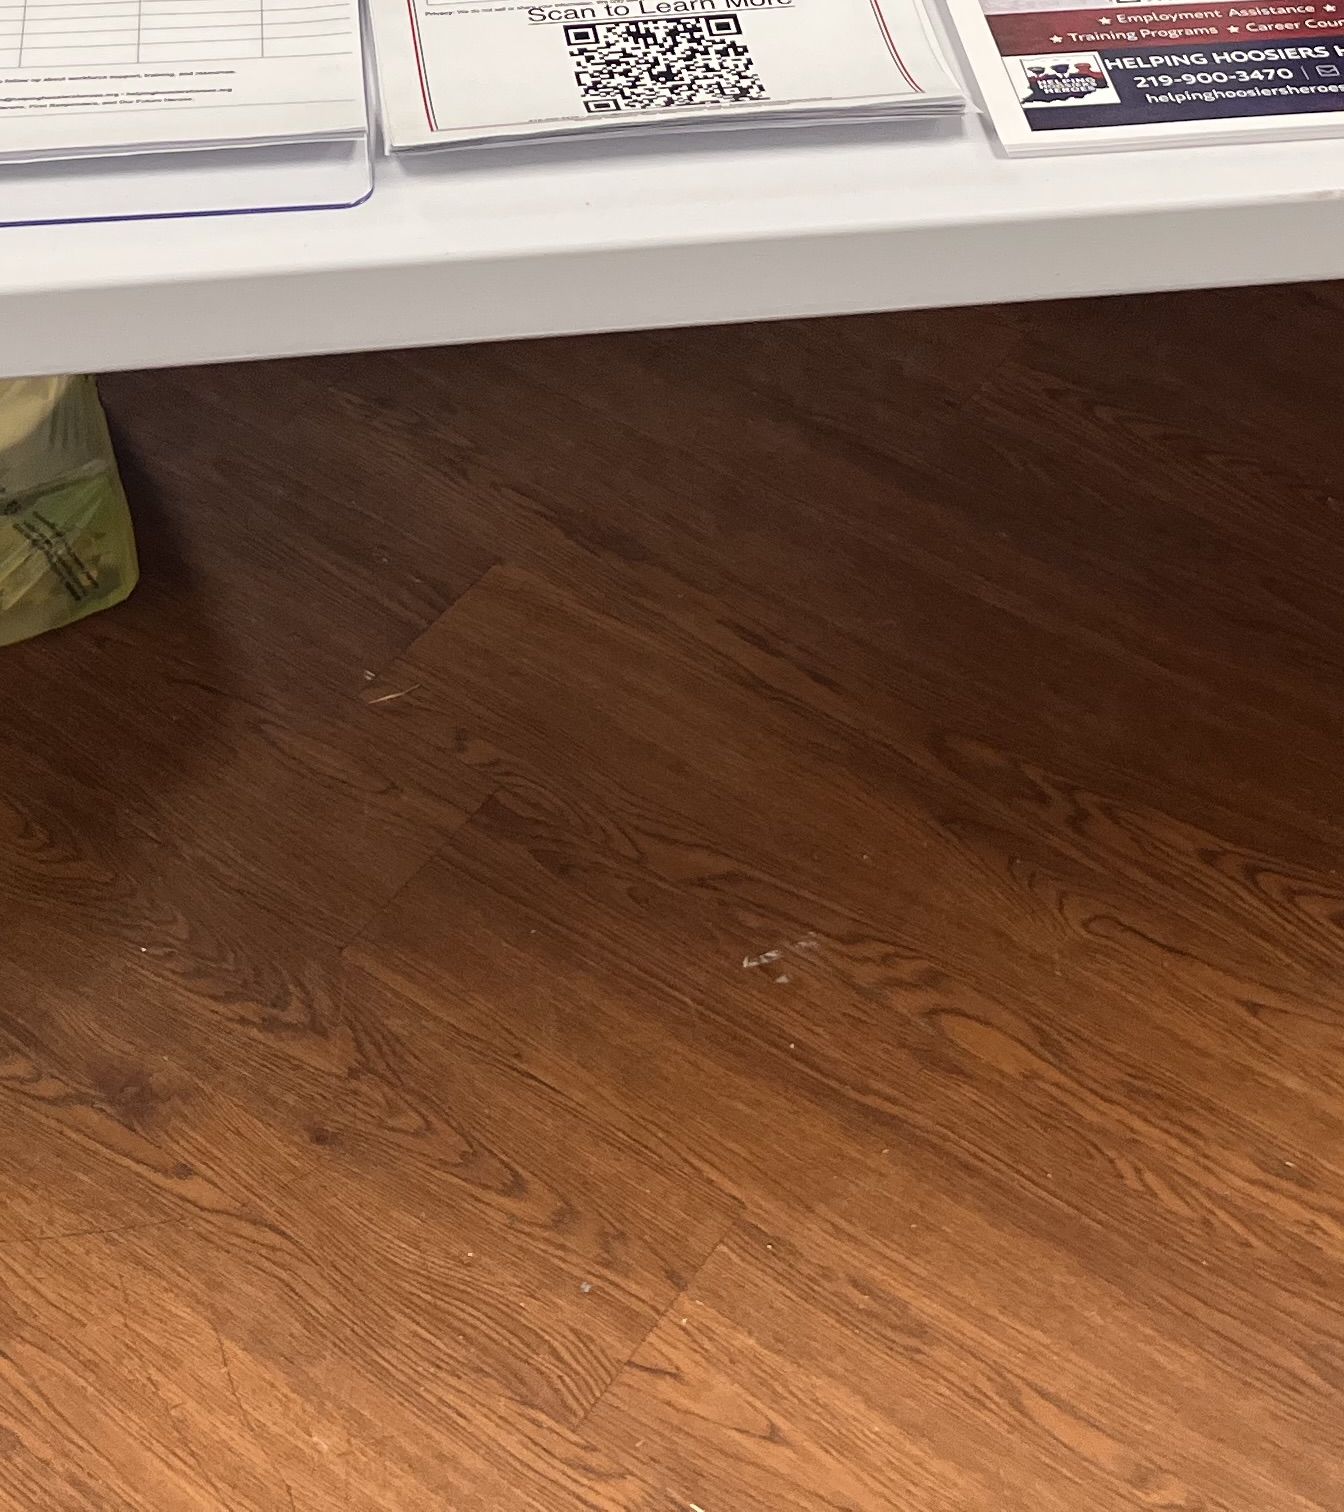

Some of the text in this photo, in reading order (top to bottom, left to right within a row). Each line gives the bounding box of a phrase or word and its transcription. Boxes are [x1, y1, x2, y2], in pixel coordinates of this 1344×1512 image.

[528, 7, 596, 22] Scan
[606, 3, 630, 17] to
[1116, 3, 1316, 25] Employment Assistance
[1066, 29, 1138, 45] Training
[1143, 24, 1218, 40] Programs
[1245, 19, 1300, 33] Career
[1104, 53, 1206, 71] HELPING
[1212, 46, 1329, 65] HOOSIERS
[1134, 67, 1293, 88] 219-900-3470
